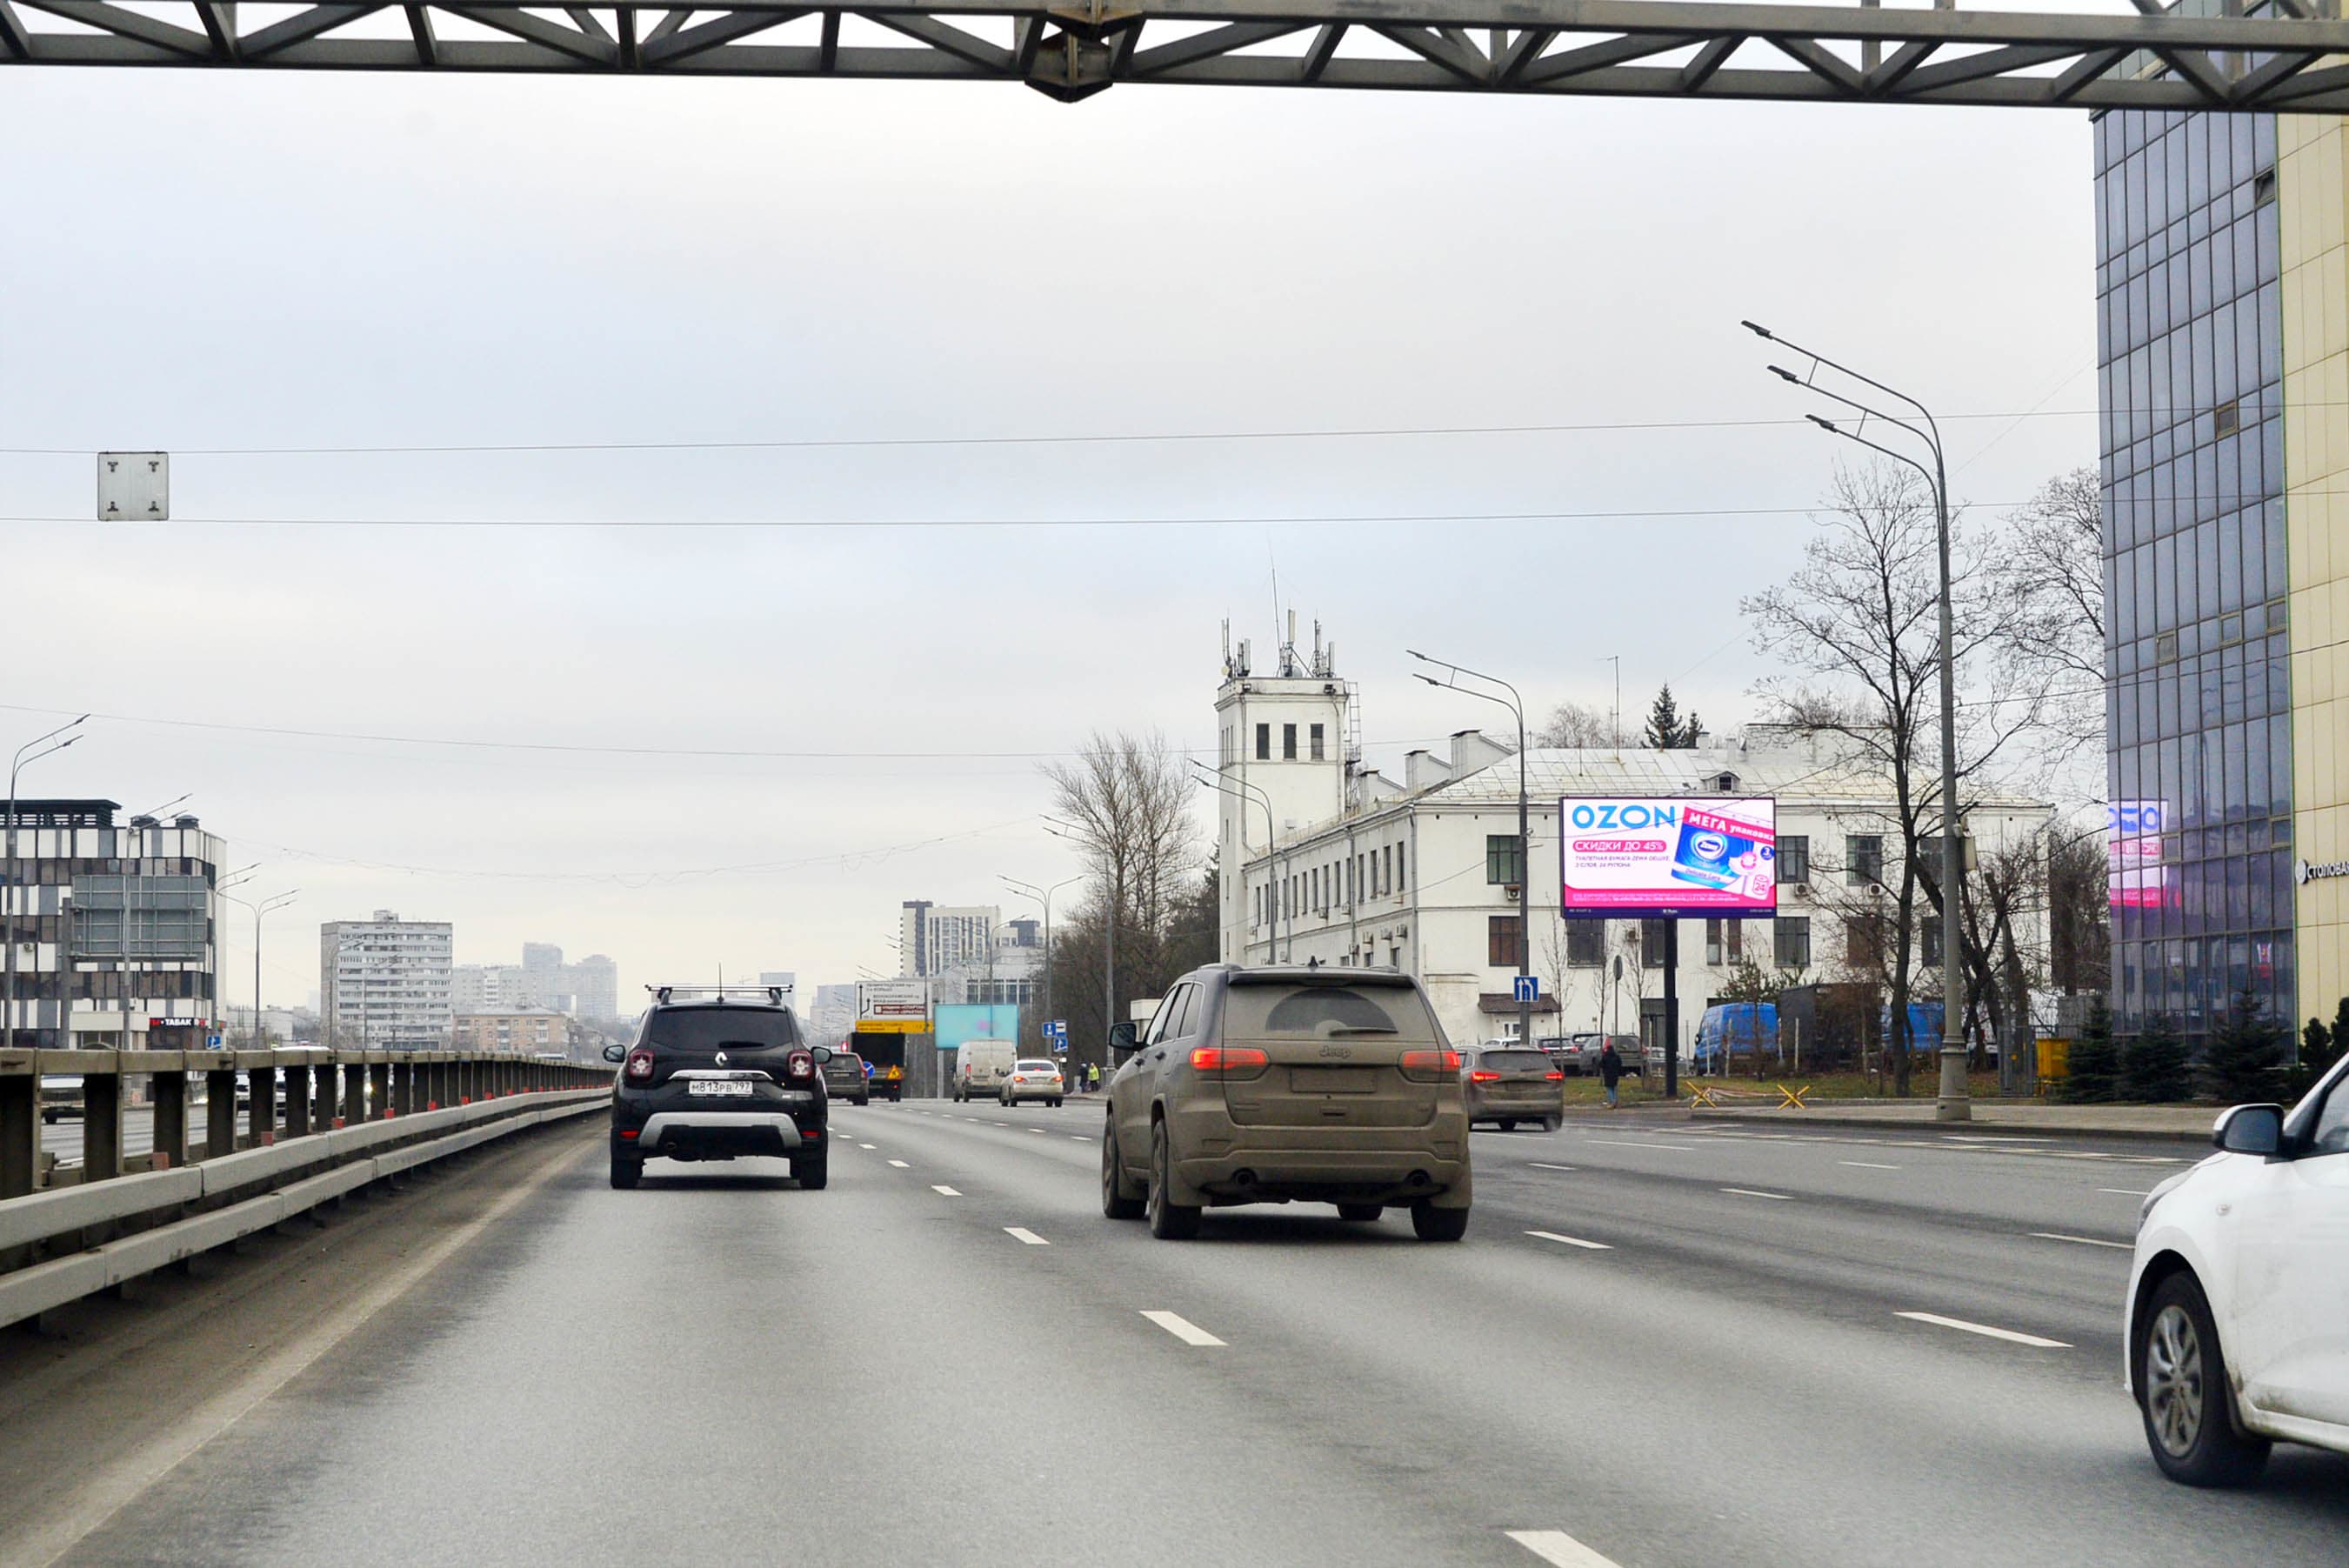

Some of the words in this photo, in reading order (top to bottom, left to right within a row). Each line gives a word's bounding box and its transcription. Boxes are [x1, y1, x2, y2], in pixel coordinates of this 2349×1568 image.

[1572, 805, 1675, 829] OZON
[1689, 812, 1726, 831] МЕГА
[1575, 842, 1621, 851] СКИДКИ
[1624, 842, 1641, 851] ДО
[1644, 842, 1664, 851] 45%
[2307, 862, 2349, 879] СТОЛОВА
[1318, 1044, 1351, 1059] Jeep
